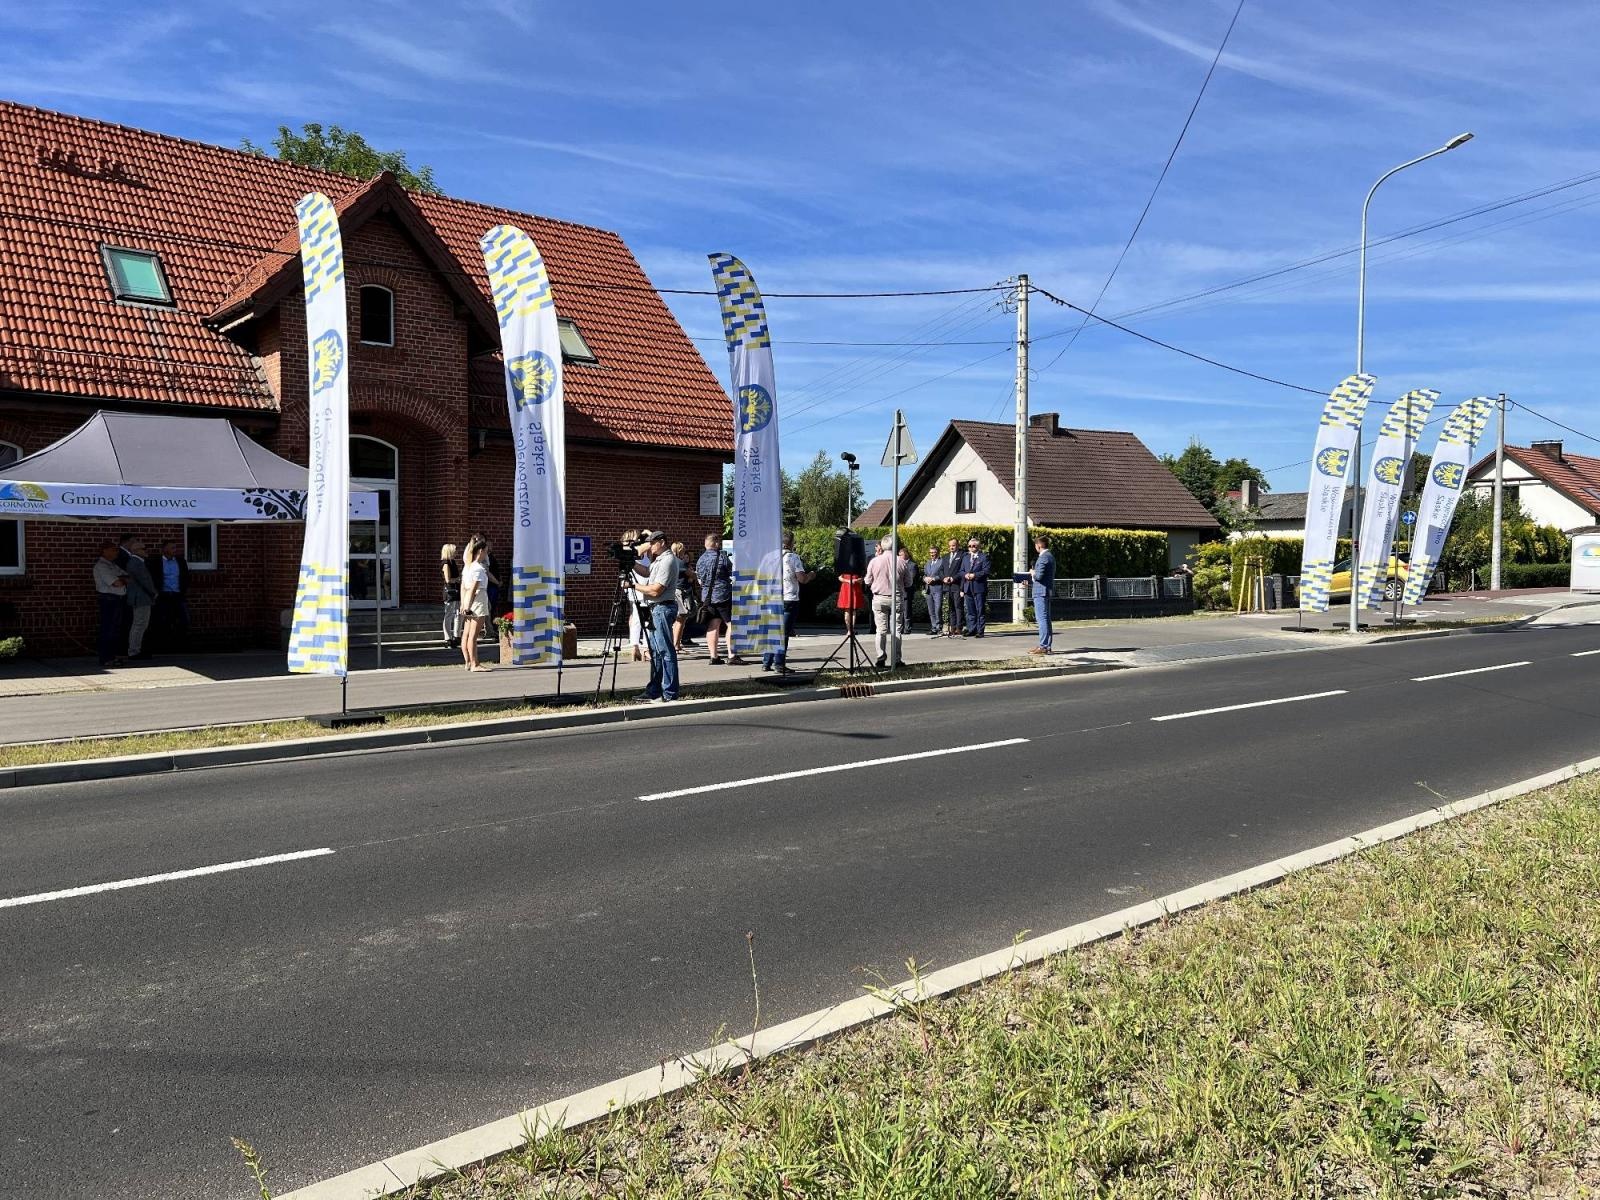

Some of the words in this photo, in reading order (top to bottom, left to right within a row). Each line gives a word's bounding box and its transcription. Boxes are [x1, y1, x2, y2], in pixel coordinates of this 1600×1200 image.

[61, 491, 116, 506] Gmina
[120, 494, 197, 508] Kornowac
[570, 538, 585, 560] P
